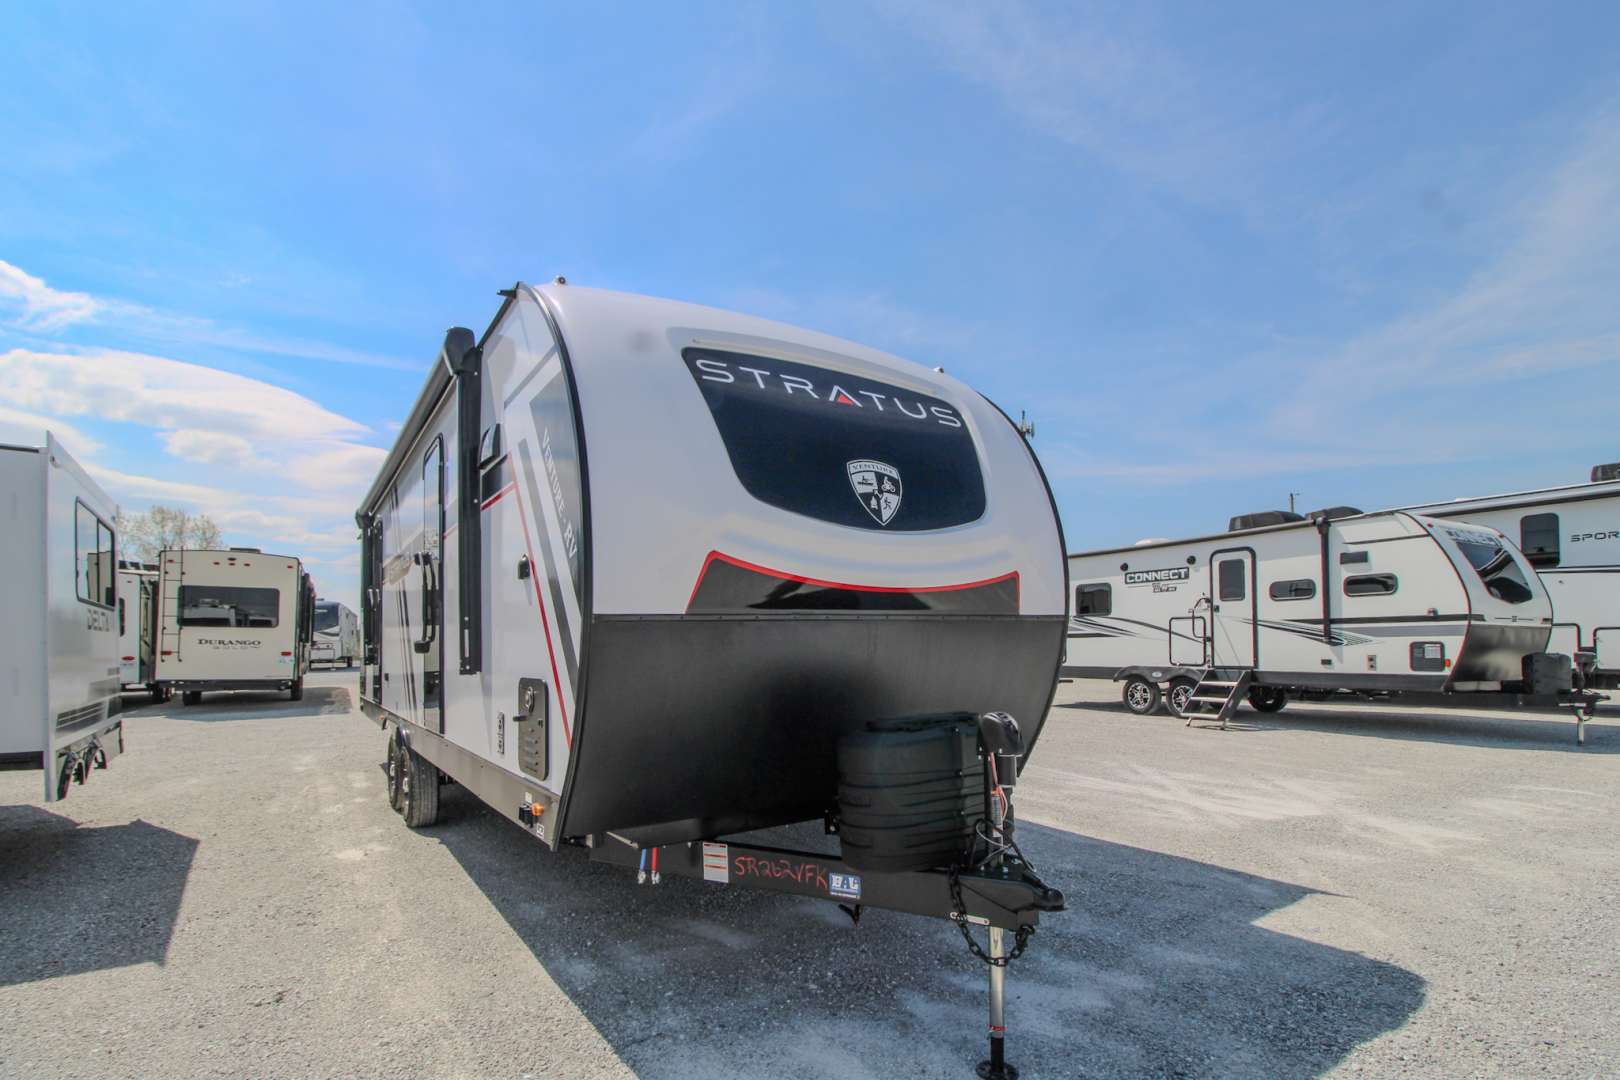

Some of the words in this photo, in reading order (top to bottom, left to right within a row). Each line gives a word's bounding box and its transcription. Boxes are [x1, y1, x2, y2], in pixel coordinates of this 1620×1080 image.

[696, 359, 962, 428] STRATUS
[542, 426, 565, 517] VENTURE
[564, 520, 577, 559] RV
[1126, 569, 1188, 583] CONNECT
[198, 638, 262, 648] DURANGO
